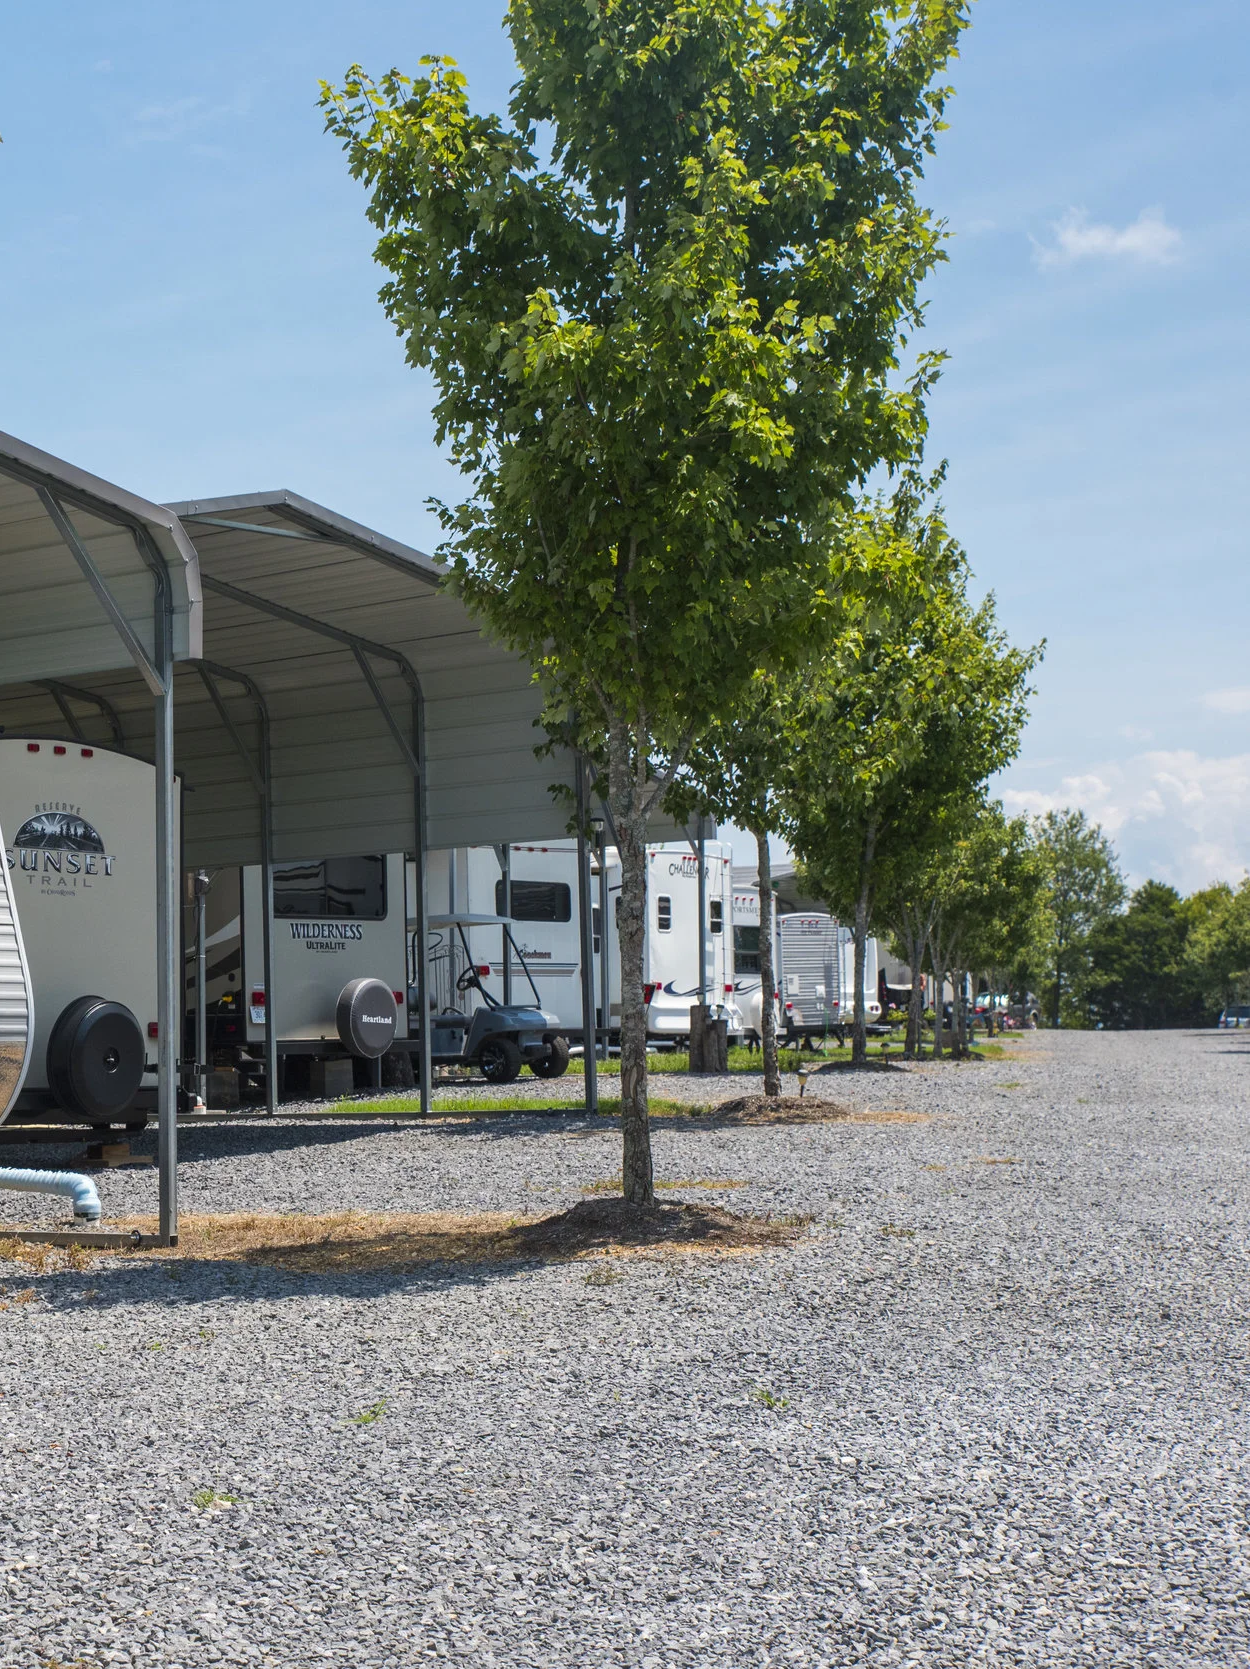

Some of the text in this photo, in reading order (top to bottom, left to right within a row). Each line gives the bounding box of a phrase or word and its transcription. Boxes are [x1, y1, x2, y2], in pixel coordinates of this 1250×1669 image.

[35, 801, 81, 815] RESERVE
[6, 848, 116, 876] SUNSET
[668, 863, 710, 880] CHALLENR
[26, 874, 93, 888] TRAIL
[290, 922, 363, 940] WILDERNESS
[362, 1014, 392, 1024] Heartland
